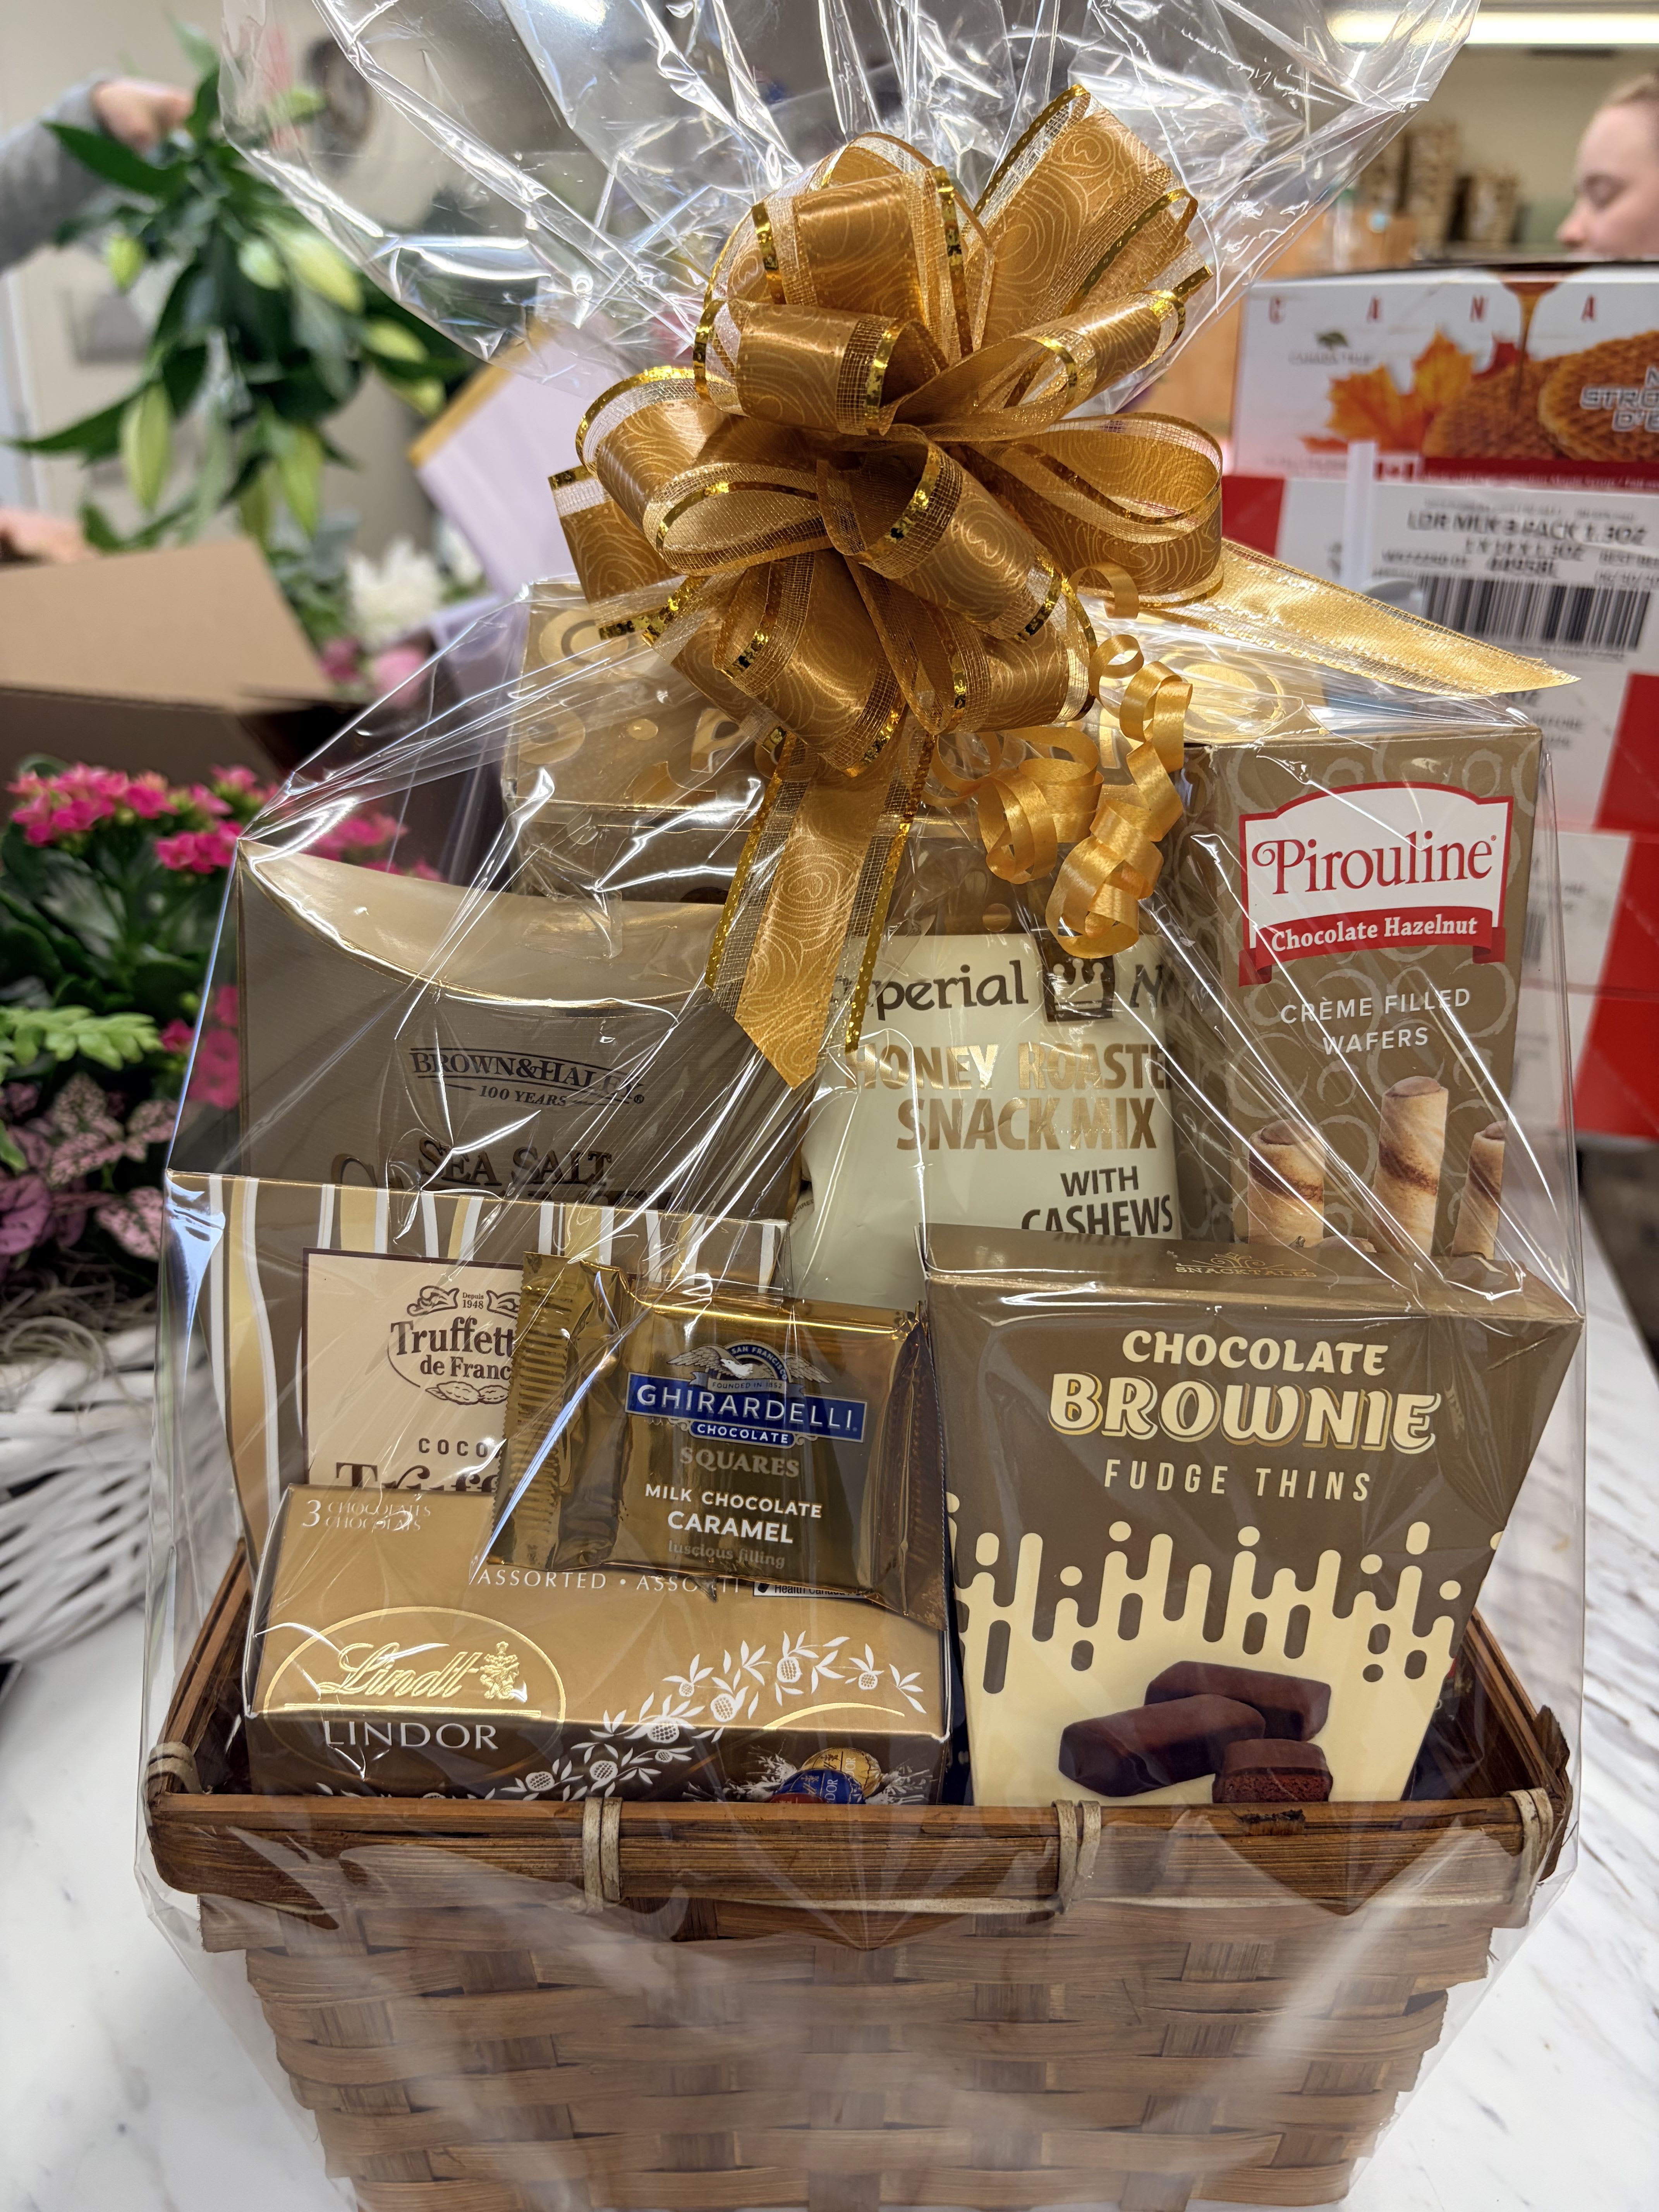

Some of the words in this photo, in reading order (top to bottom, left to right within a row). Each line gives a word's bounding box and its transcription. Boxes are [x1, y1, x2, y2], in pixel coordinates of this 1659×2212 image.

[1252, 830, 1493, 895] Pirouline
[1272, 921, 1377, 952] Chocolate
[1384, 915, 1477, 938] Hazelnut
[833, 960, 1029, 1021] perial
[1280, 997, 1372, 1024] CRÈME
[1384, 988, 1470, 1015] FILLED
[1322, 1027, 1429, 1055] WAFERS
[845, 1043, 999, 1090] HONEY
[479, 1085, 510, 1100] 100
[514, 1091, 567, 1106] YEARS
[897, 1097, 1061, 1150] SNACK
[1070, 1097, 1156, 1150] MIX
[418, 1137, 502, 1186] SEA
[512, 1146, 613, 1186] SALT
[1060, 1166, 1139, 1197] WITH
[1021, 1195, 1173, 1236] CASHEWS
[462, 1300, 484, 1310] 1948
[420, 1354, 445, 1375] de
[450, 1356, 511, 1380] Franc
[731, 1346, 748, 1354] SAN
[752, 1347, 787, 1380] FRANCISCO
[1122, 1329, 1388, 1376] CHOCOLATE
[637, 1384, 852, 1431] GHIRARDELLI
[1047, 1371, 1441, 1454] BROWNIE
[419, 1438, 500, 1458] COCO
[697, 1424, 788, 1444] CHOCOLATE
[680, 1447, 800, 1477] SQUARES
[1104, 1459, 1228, 1494] FUDGE
[1255, 1468, 1370, 1501] THINS
[301, 1499, 321, 1527] 3
[645, 1484, 692, 1502] MILK
[701, 1491, 823, 1518] CHOCOLATE
[668, 1511, 793, 1544] CARAMEL
[668, 1540, 733, 1559] luscious
[737, 1549, 785, 1569] filling
[477, 1569, 606, 1590] ASSORTED
[636, 1575, 738, 1593] ASSOTI
[318, 1642, 483, 1698] Lindt
[324, 1721, 499, 1750] LINDOR
